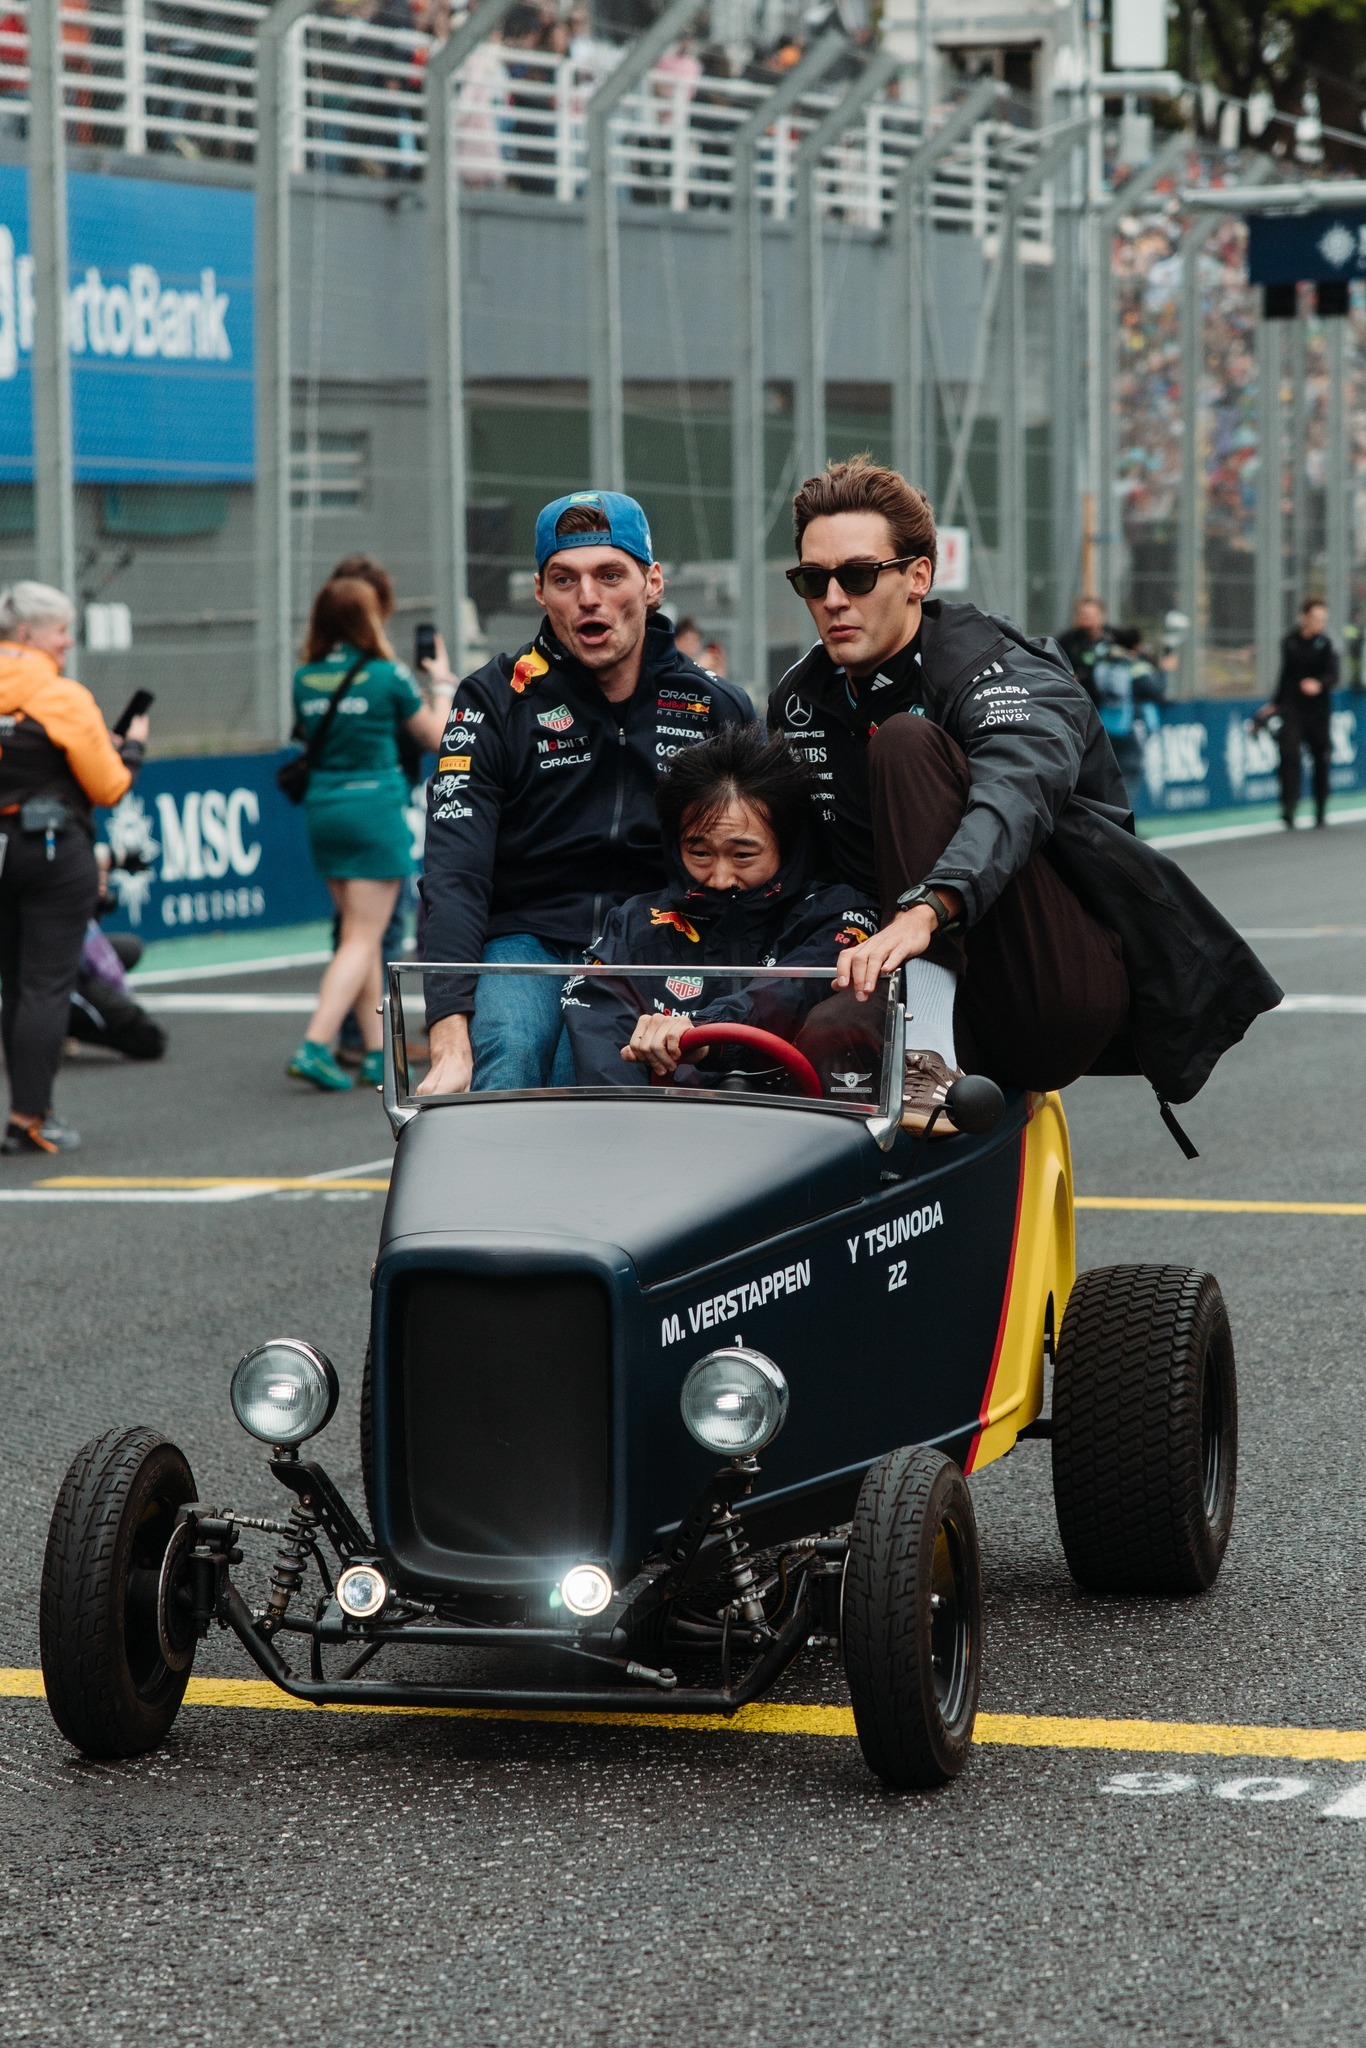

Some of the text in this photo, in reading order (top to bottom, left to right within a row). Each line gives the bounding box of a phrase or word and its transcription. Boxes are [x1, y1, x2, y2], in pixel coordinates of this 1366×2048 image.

[659, 689, 711, 704] ORACLE
[982, 685, 1030, 697] SOLERA
[657, 699, 687, 710] Red Bull
[539, 706, 569, 722] TAG
[656, 709, 709, 722] RACING
[541, 715, 573, 731] HEUER
[656, 725, 705, 740] HONDA
[794, 731, 825, 739] AMG
[537, 737, 574, 754] Mobil
[540, 752, 592, 769] ORACLE
[439, 800, 461, 811] AVA
[433, 807, 473, 821] TRADE
[155, 787, 262, 882] MSC
[667, 980, 700, 1000] HEUER
[847, 1201, 944, 1264] Y TSUNODA
[888, 1260, 908, 1292] 22
[661, 1259, 811, 1347] M. VERSTAPPEN
